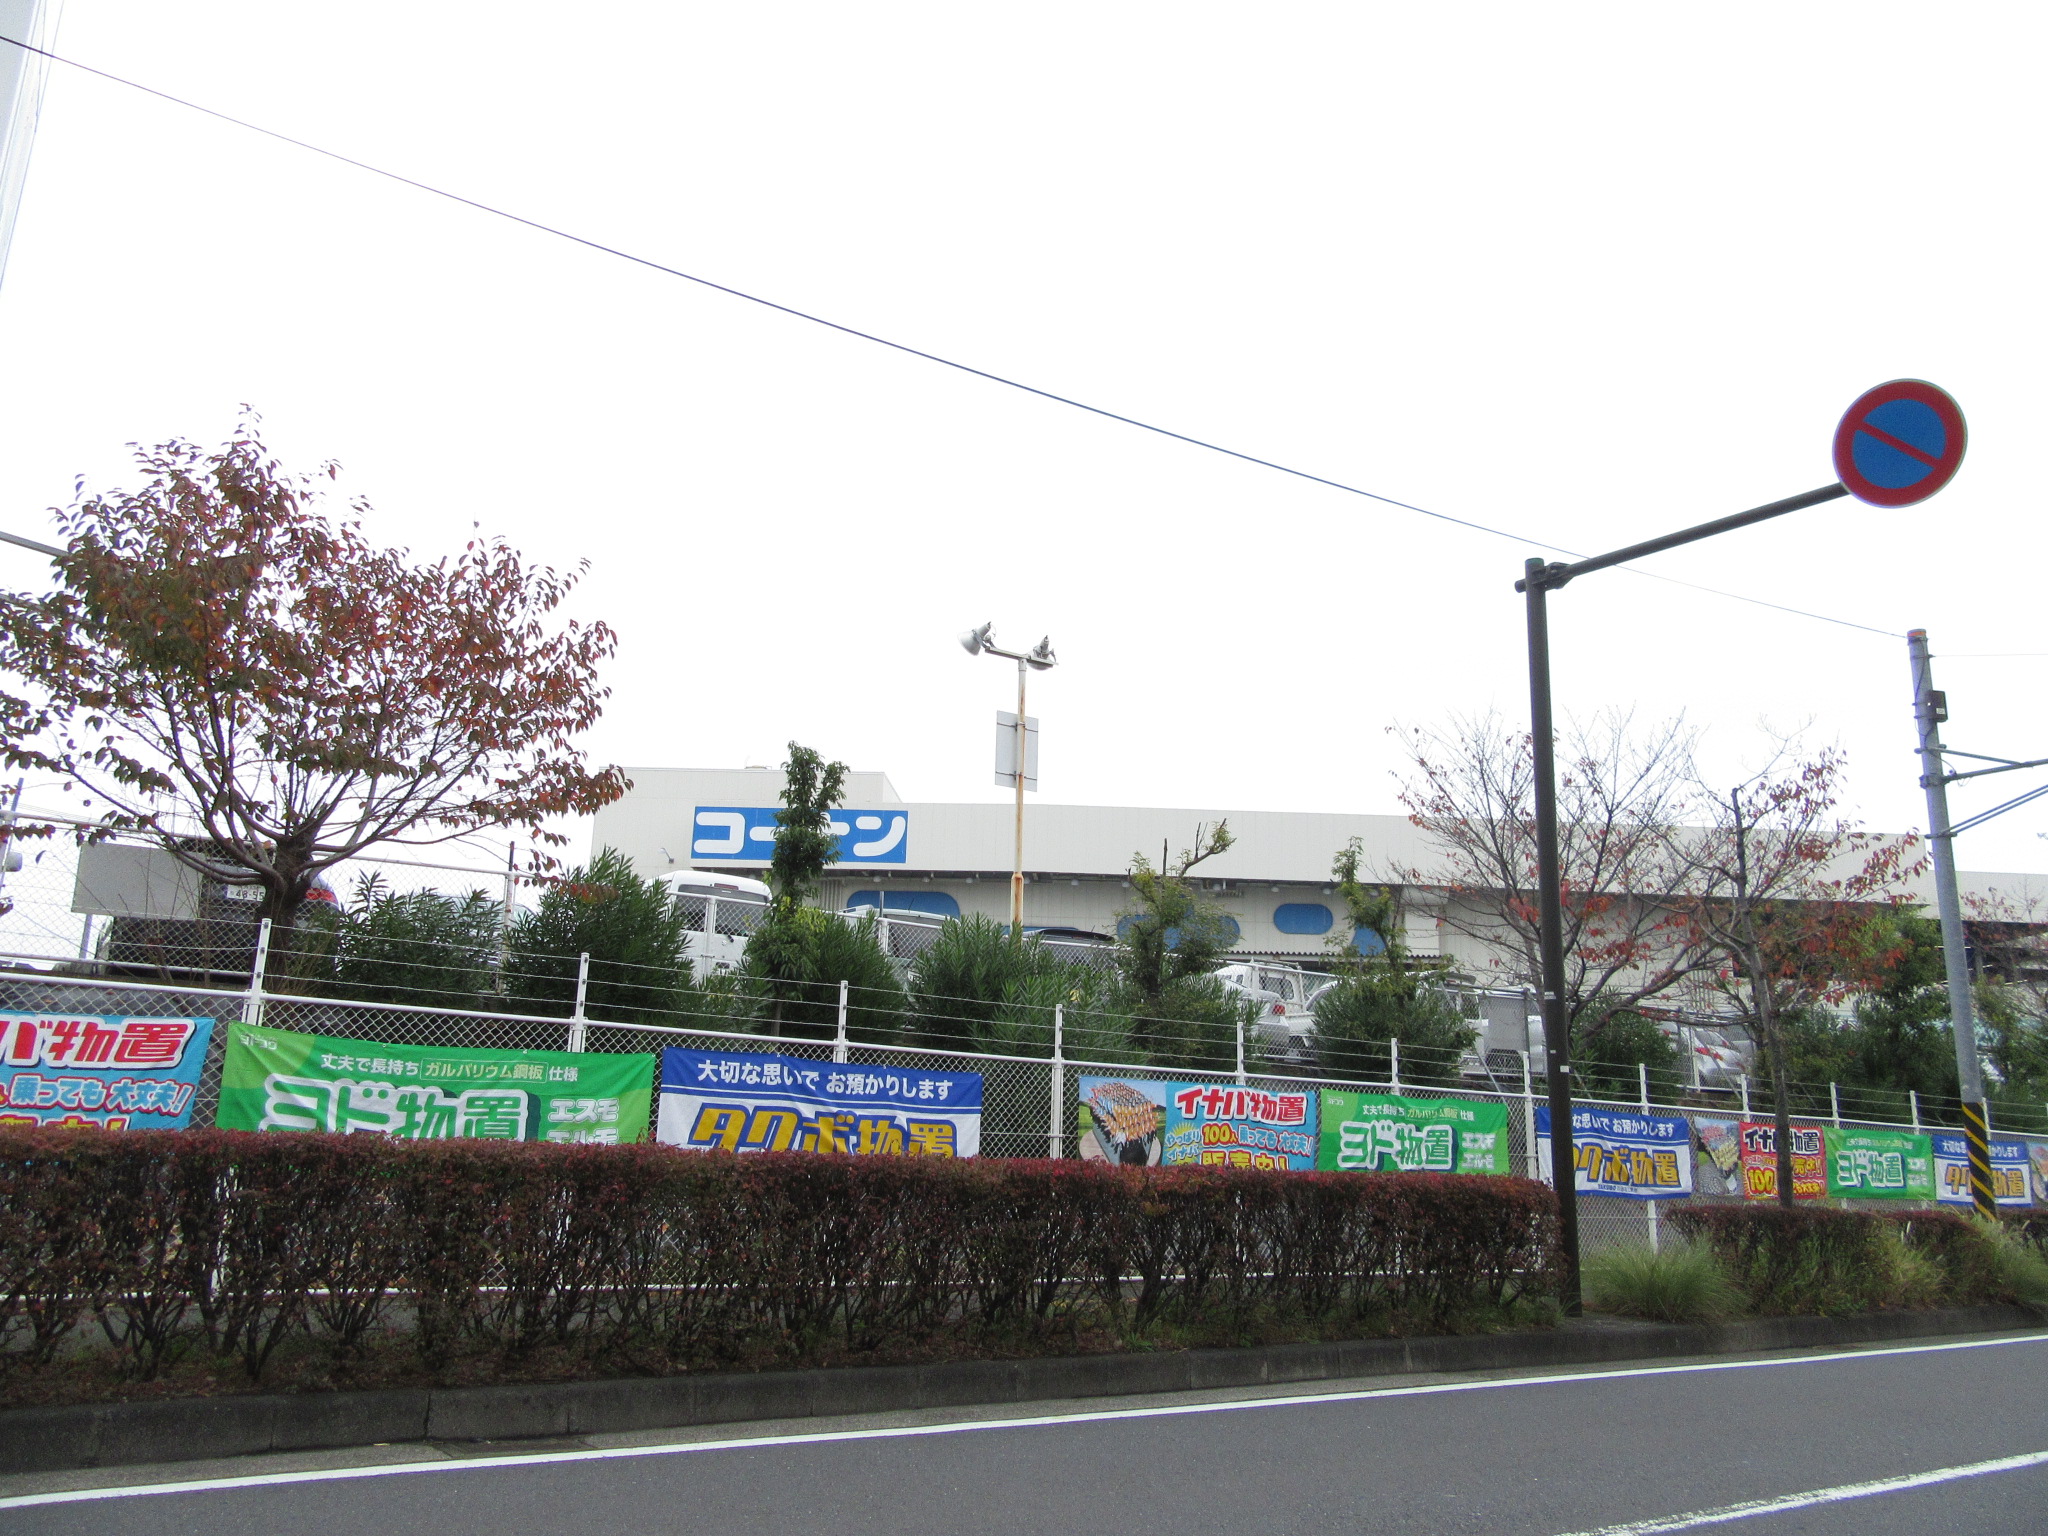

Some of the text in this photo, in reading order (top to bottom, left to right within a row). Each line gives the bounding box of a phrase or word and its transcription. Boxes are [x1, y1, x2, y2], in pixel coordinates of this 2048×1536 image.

[321, 1053, 579, 1082] 丈夫で長持ち ガルバリウム鋼板 仕様
[698, 1060, 953, 1101] 大切な思いで お預かりします
[11, 1075, 106, 1107] 乗っても
[259, 1073, 528, 1141] ヨド物置
[1176, 1086, 1307, 1125] イナバ物置
[549, 1098, 619, 1123] エスモ
[1612, 1118, 1675, 1137] お預かりします
[691, 1106, 955, 1156] タクボ物置
[1239, 1125, 1278, 1149] 乗っても
[1338, 1120, 1452, 1170] ヨド物置
[1744, 1127, 1820, 1154] イナ物置
[1836, 1149, 1904, 1187] ヨド物置
[1945, 1164, 2025, 1198] タク物置
